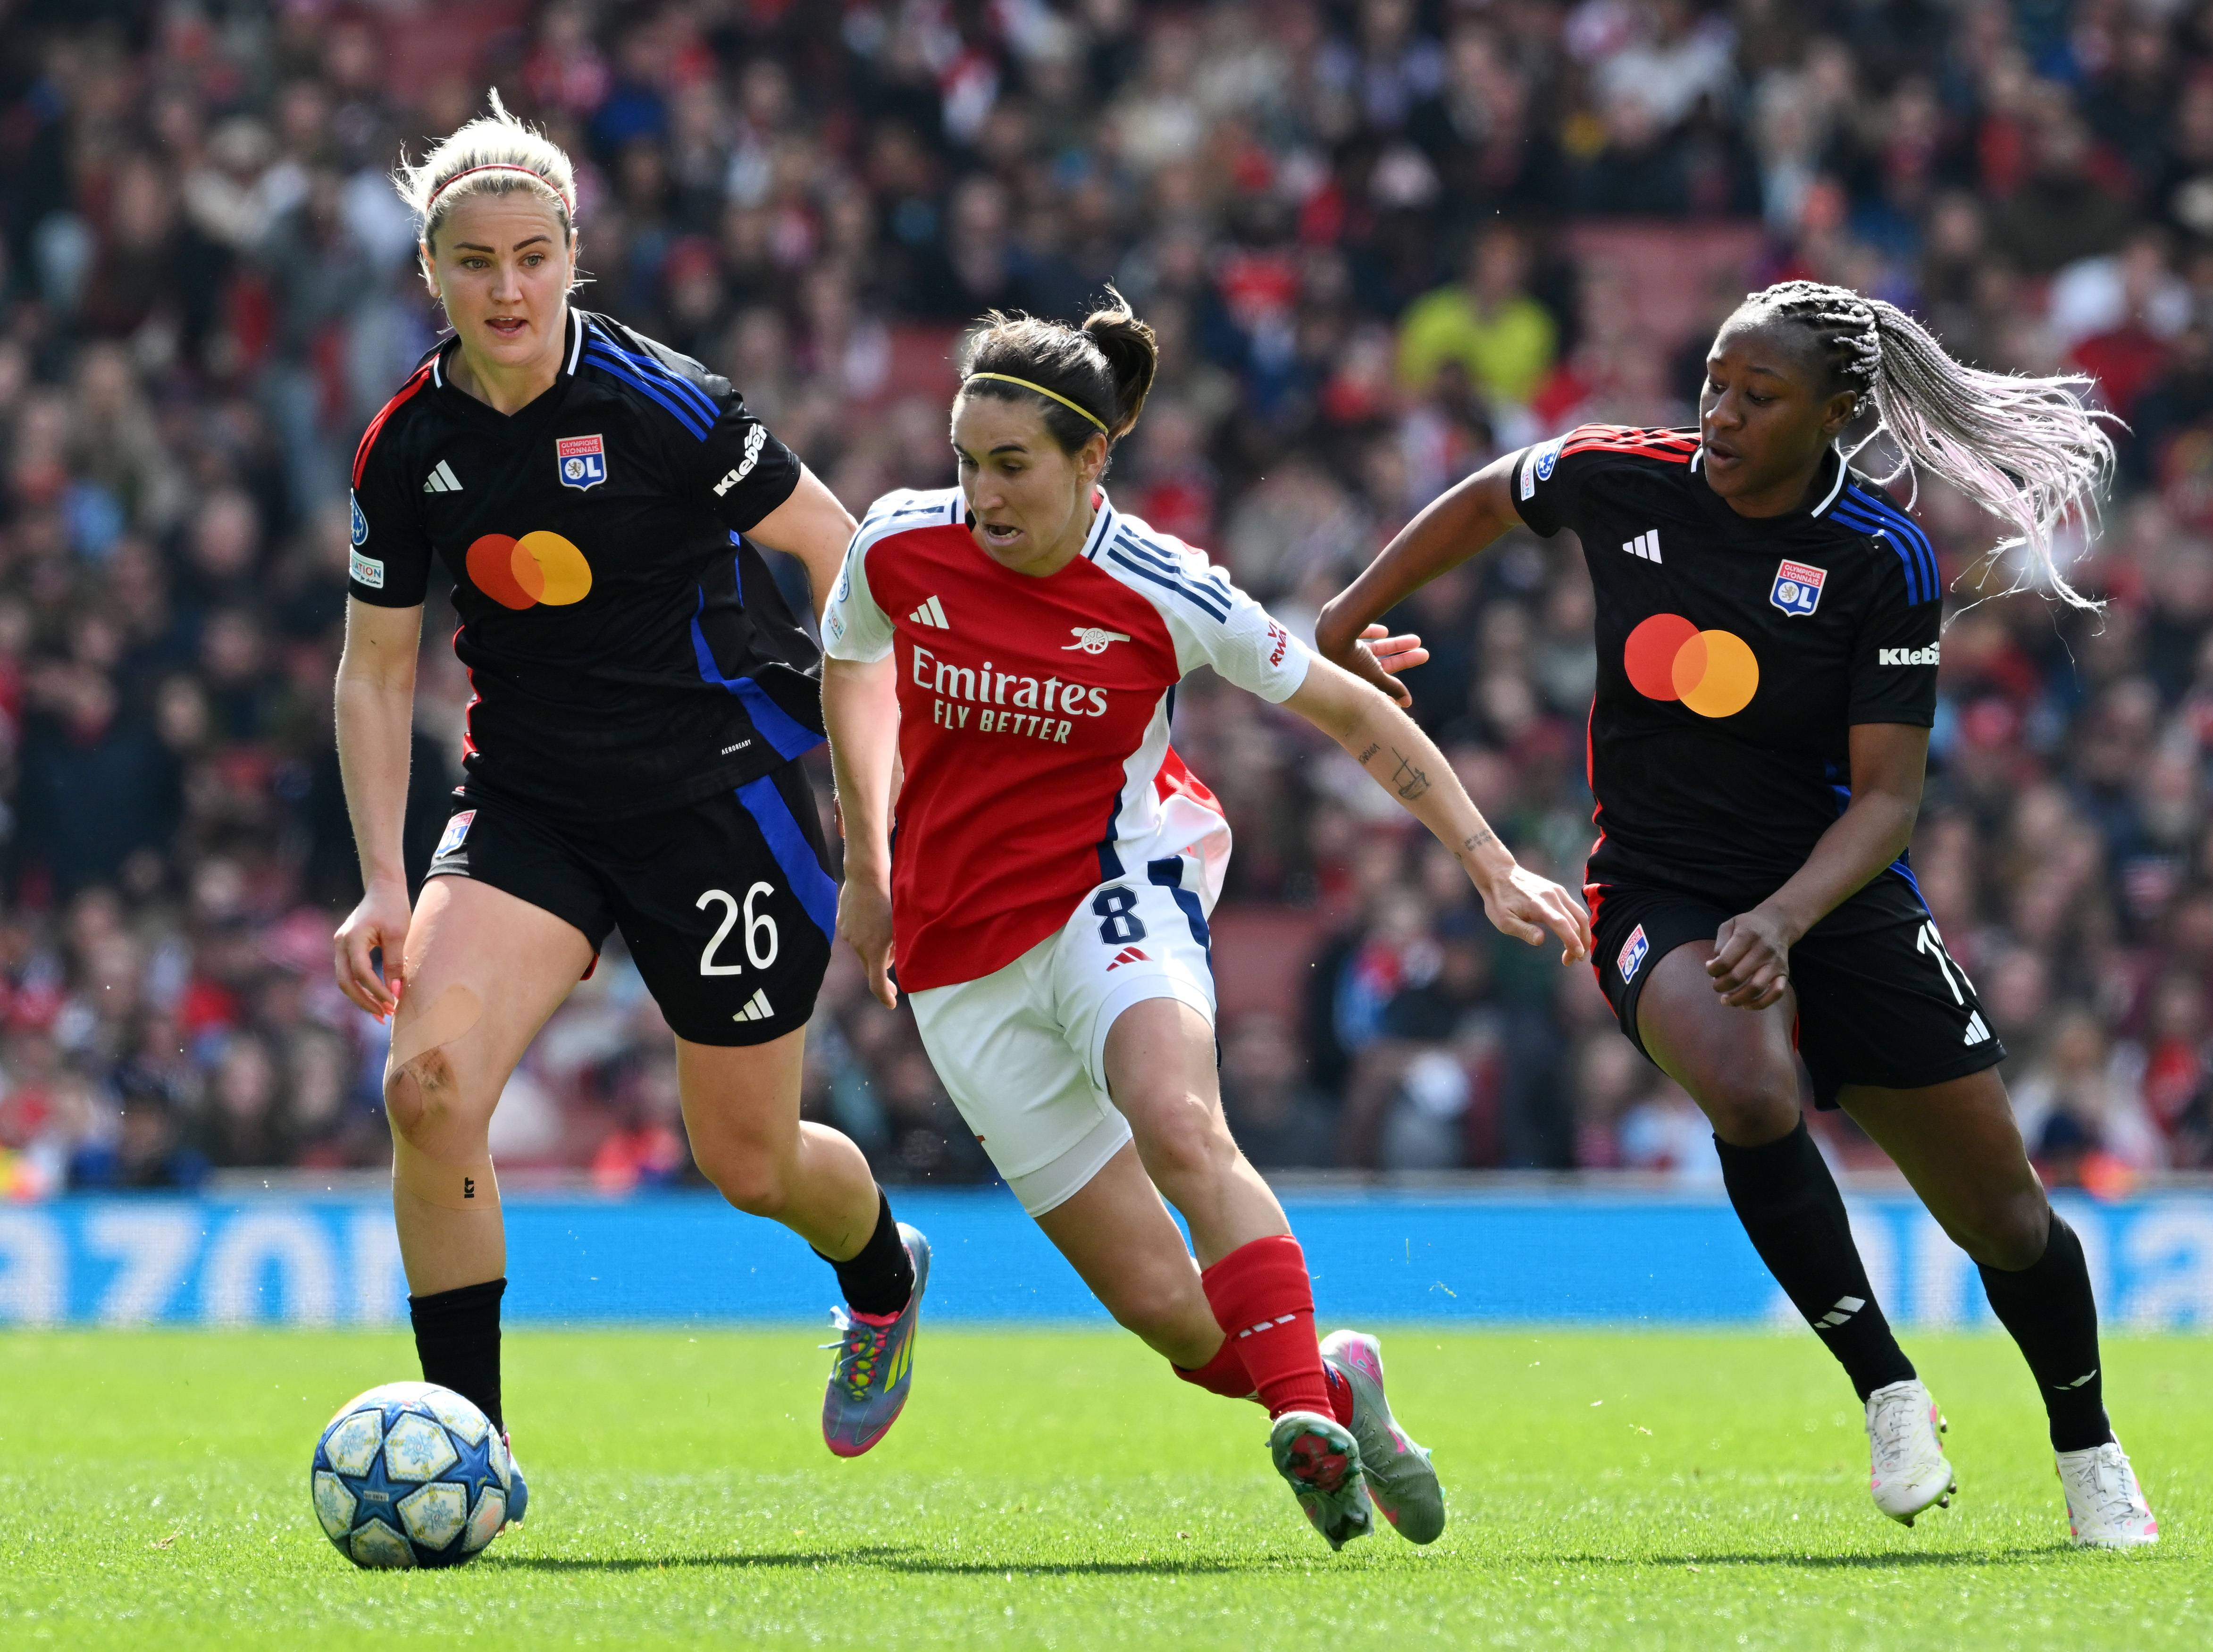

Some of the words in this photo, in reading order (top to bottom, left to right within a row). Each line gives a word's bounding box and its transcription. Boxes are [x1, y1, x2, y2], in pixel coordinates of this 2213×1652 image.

[562, 439, 598, 448] OLYMPIQUE
[562, 445, 599, 455] LYONNAIS
[713, 424, 767, 497] Kleber
[1782, 570, 1819, 585] LYONNAIS
[1785, 564, 1821, 579] OLYMPIQUE
[1879, 647, 1939, 665] Kleb
[913, 645, 1107, 717] Emirates
[934, 699, 970, 730] FLY
[979, 709, 1072, 744] BETTER
[721, 739, 751, 755] AEROREADY
[1090, 884, 1148, 946] 8
[696, 881, 778, 975] 26
